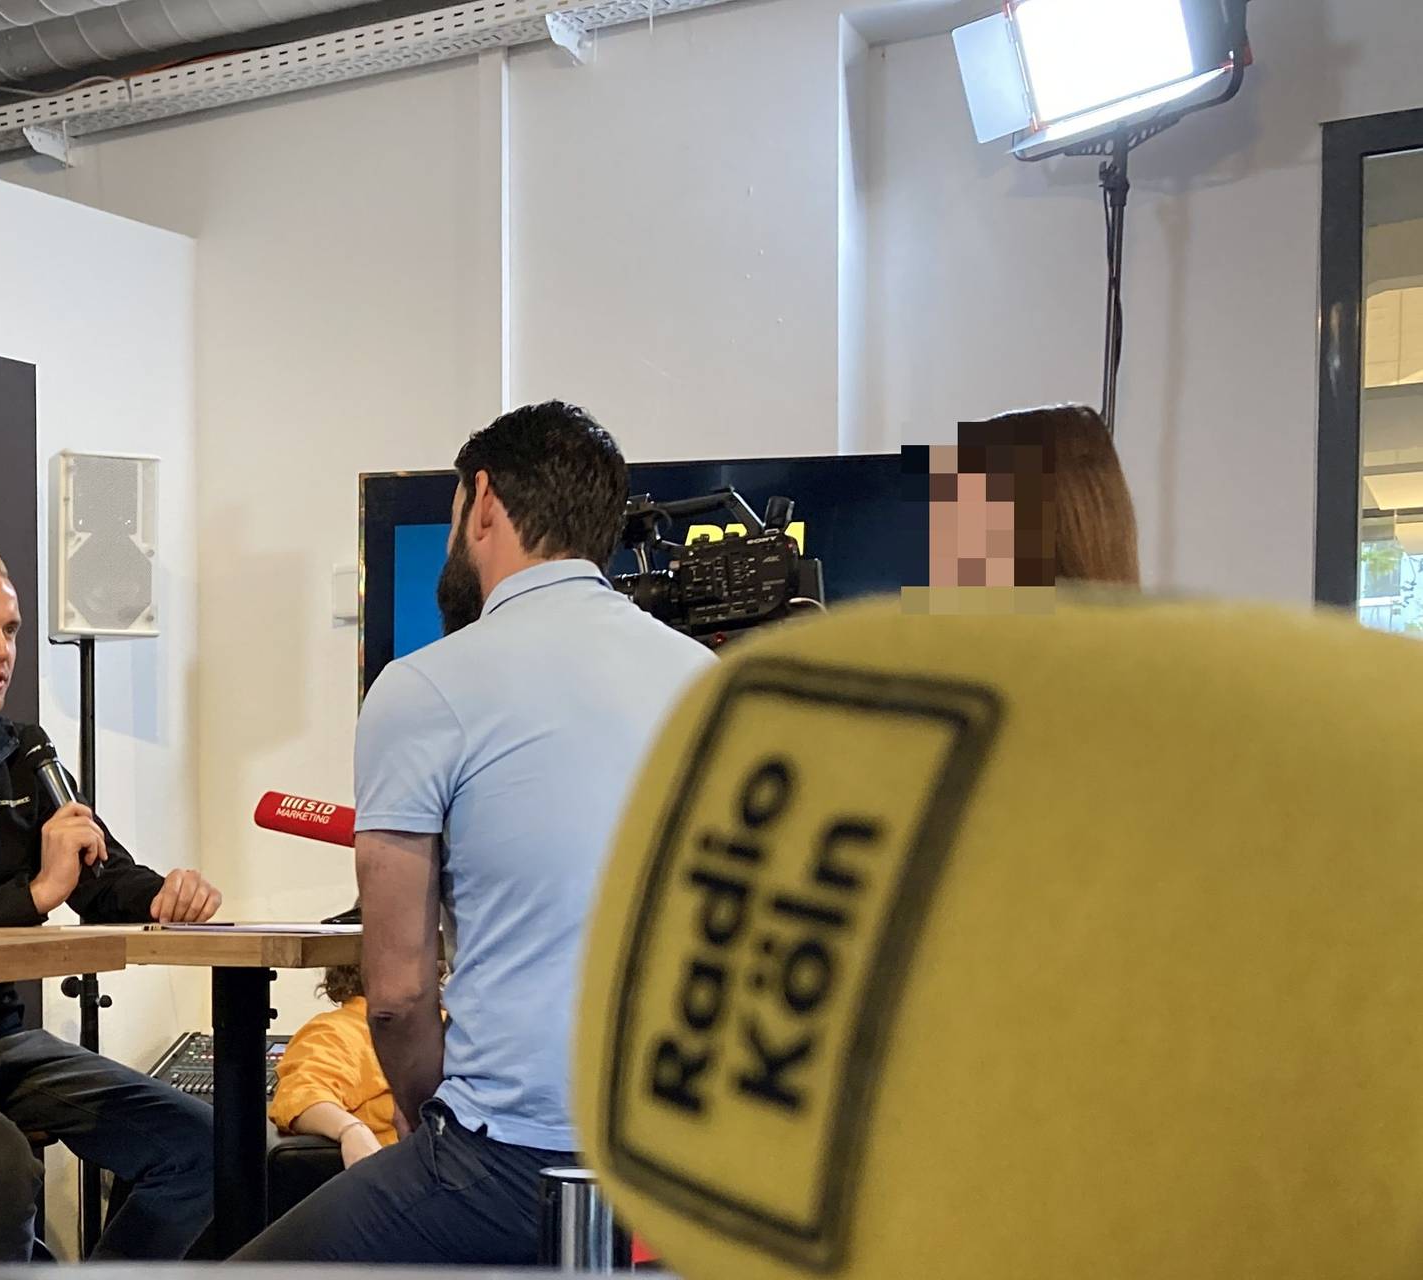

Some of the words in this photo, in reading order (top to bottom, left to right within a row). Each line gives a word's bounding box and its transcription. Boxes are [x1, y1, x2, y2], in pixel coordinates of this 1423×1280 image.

[746, 535, 778, 545] SONY
[276, 808, 331, 824] MARKETING
[650, 754, 796, 1116] Radio
[738, 816, 882, 1116] Köln
